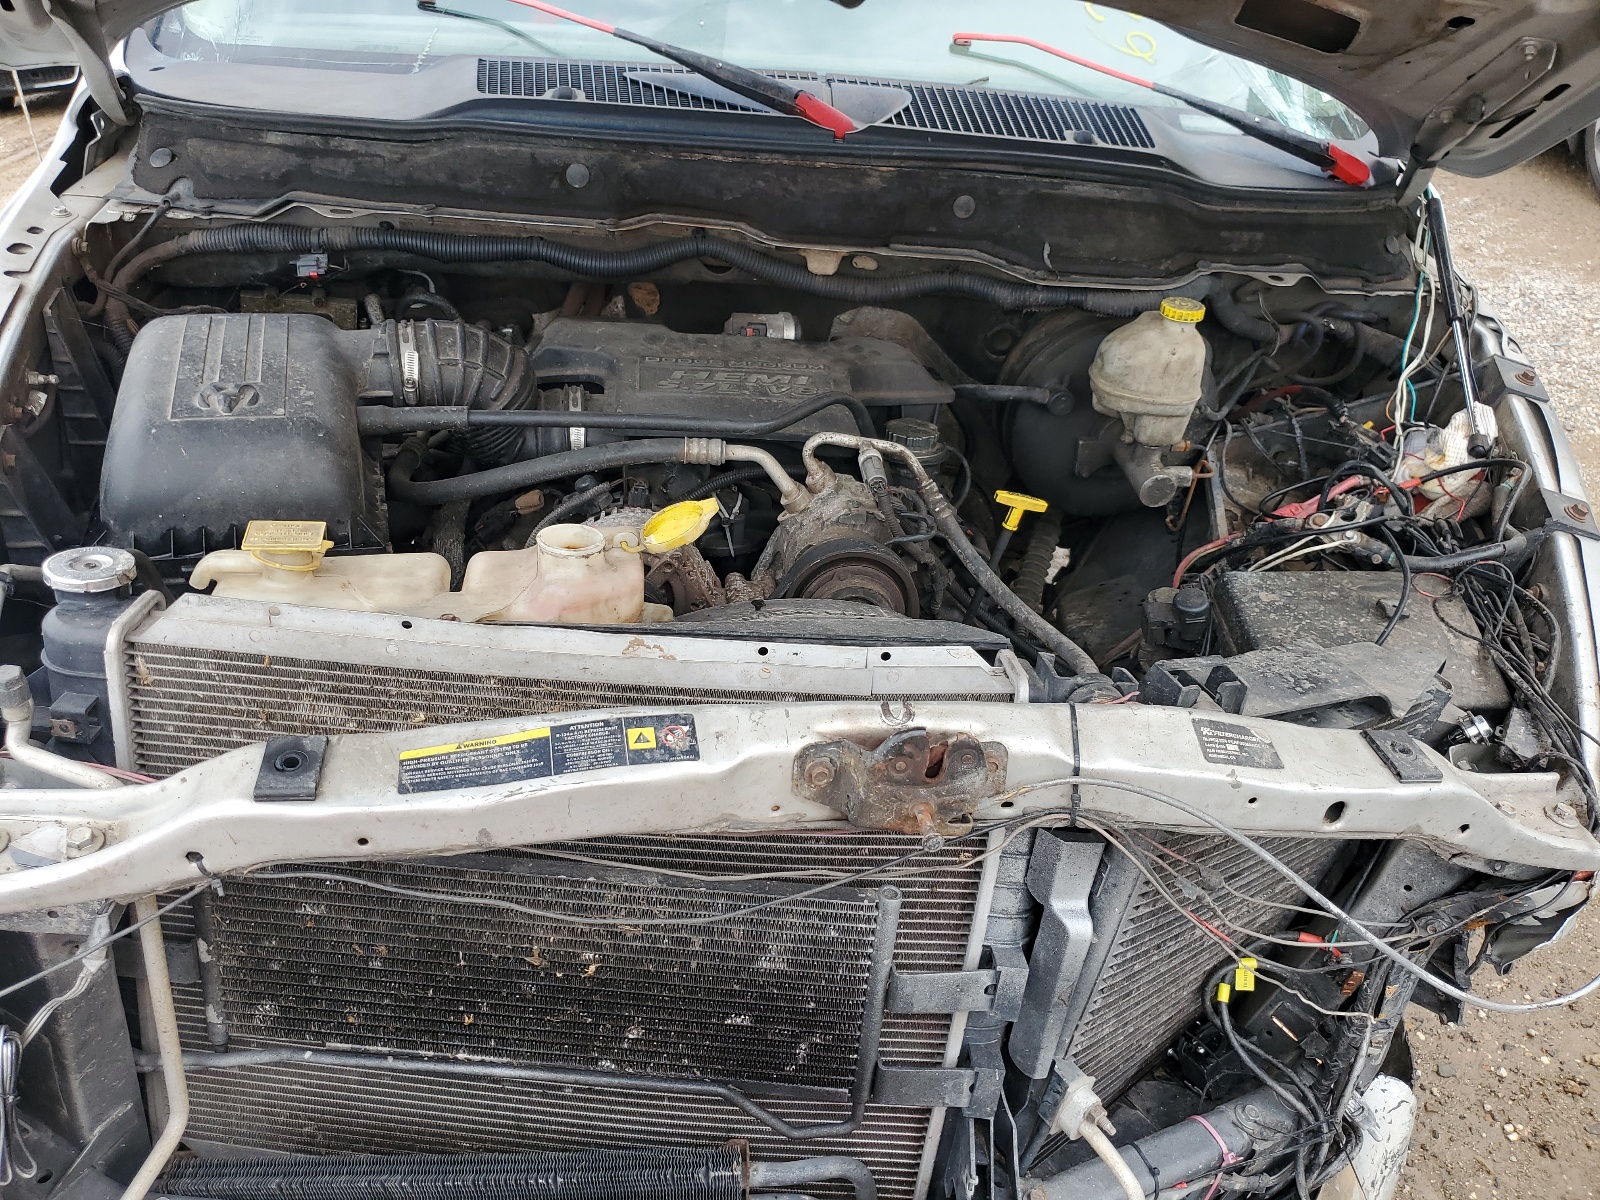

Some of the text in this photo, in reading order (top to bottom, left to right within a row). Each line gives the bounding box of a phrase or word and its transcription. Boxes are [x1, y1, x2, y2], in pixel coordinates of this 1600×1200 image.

[668, 370, 811, 385] HEMI
[569, 721, 604, 731] ATTENTION
[463, 739, 497, 749] WARNING
[403, 755, 449, 765] HIGH-PRESSURE
